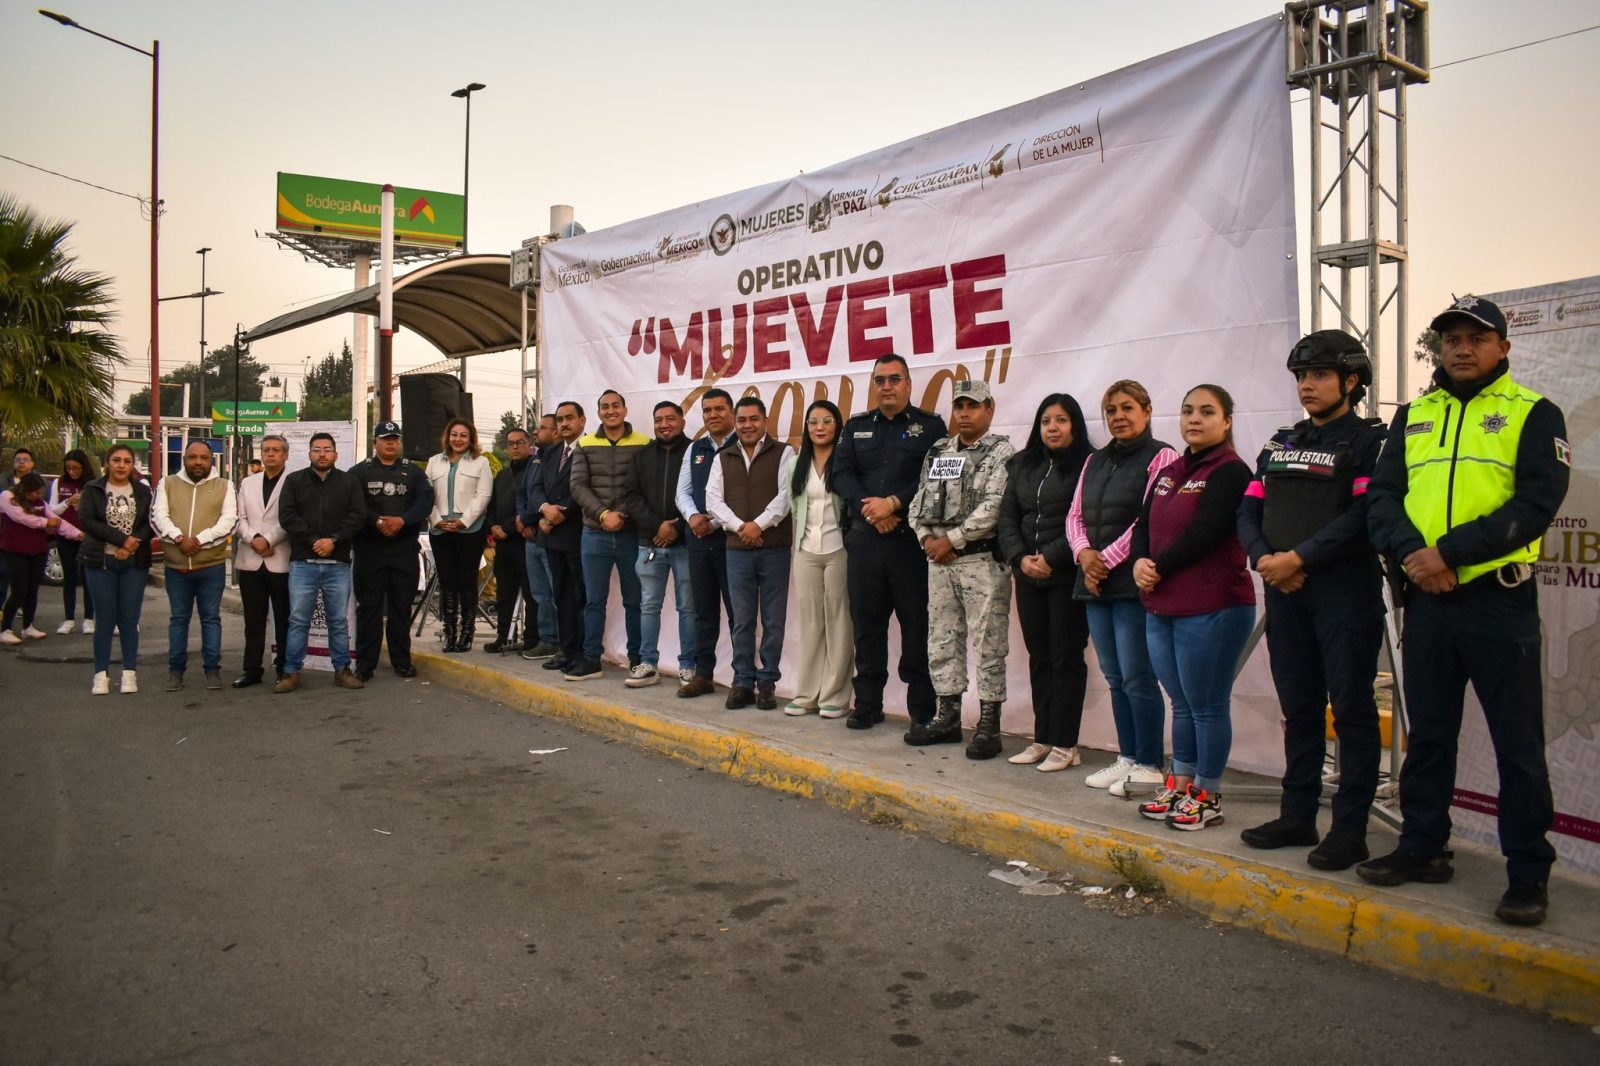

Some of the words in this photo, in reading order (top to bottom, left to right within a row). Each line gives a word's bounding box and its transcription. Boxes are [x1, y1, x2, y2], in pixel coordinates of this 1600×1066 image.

[1032, 149, 1045, 160] DE
[1047, 145, 1060, 158] LA
[1061, 136, 1094, 153] MUJER
[893, 161, 981, 195] CHICOLOAPAN
[831, 188, 868, 203] JORNADA
[843, 196, 867, 216] PAZ
[741, 203, 805, 236] MUJERES
[600, 249, 651, 272] Gobernación
[737, 239, 884, 296] OPERATIVO
[558, 271, 590, 289] México
[936, 459, 962, 468] GUARDIA
[1300, 451, 1336, 467] ESTATAL
[931, 468, 960, 477] NACIONAL
[1550, 516, 1588, 528] entro
[1536, 565, 1560, 574] para
[1543, 575, 1558, 586] las
